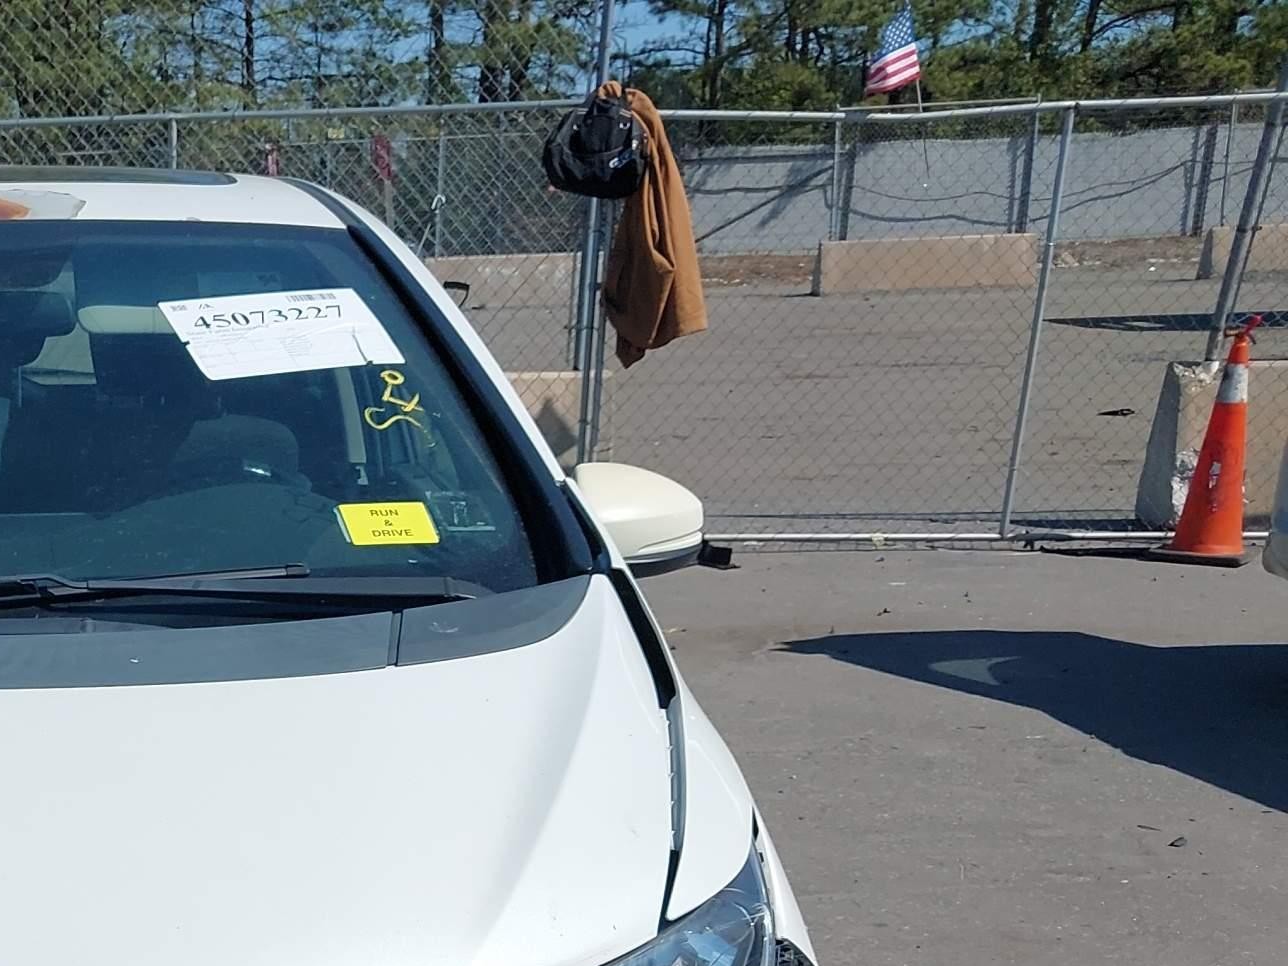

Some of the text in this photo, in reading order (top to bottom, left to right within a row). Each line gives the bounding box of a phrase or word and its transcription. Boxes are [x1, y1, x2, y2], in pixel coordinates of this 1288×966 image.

[193, 304, 343, 330] 45073227
[369, 509, 399, 517] RUN
[372, 529, 414, 537] DRIVE
